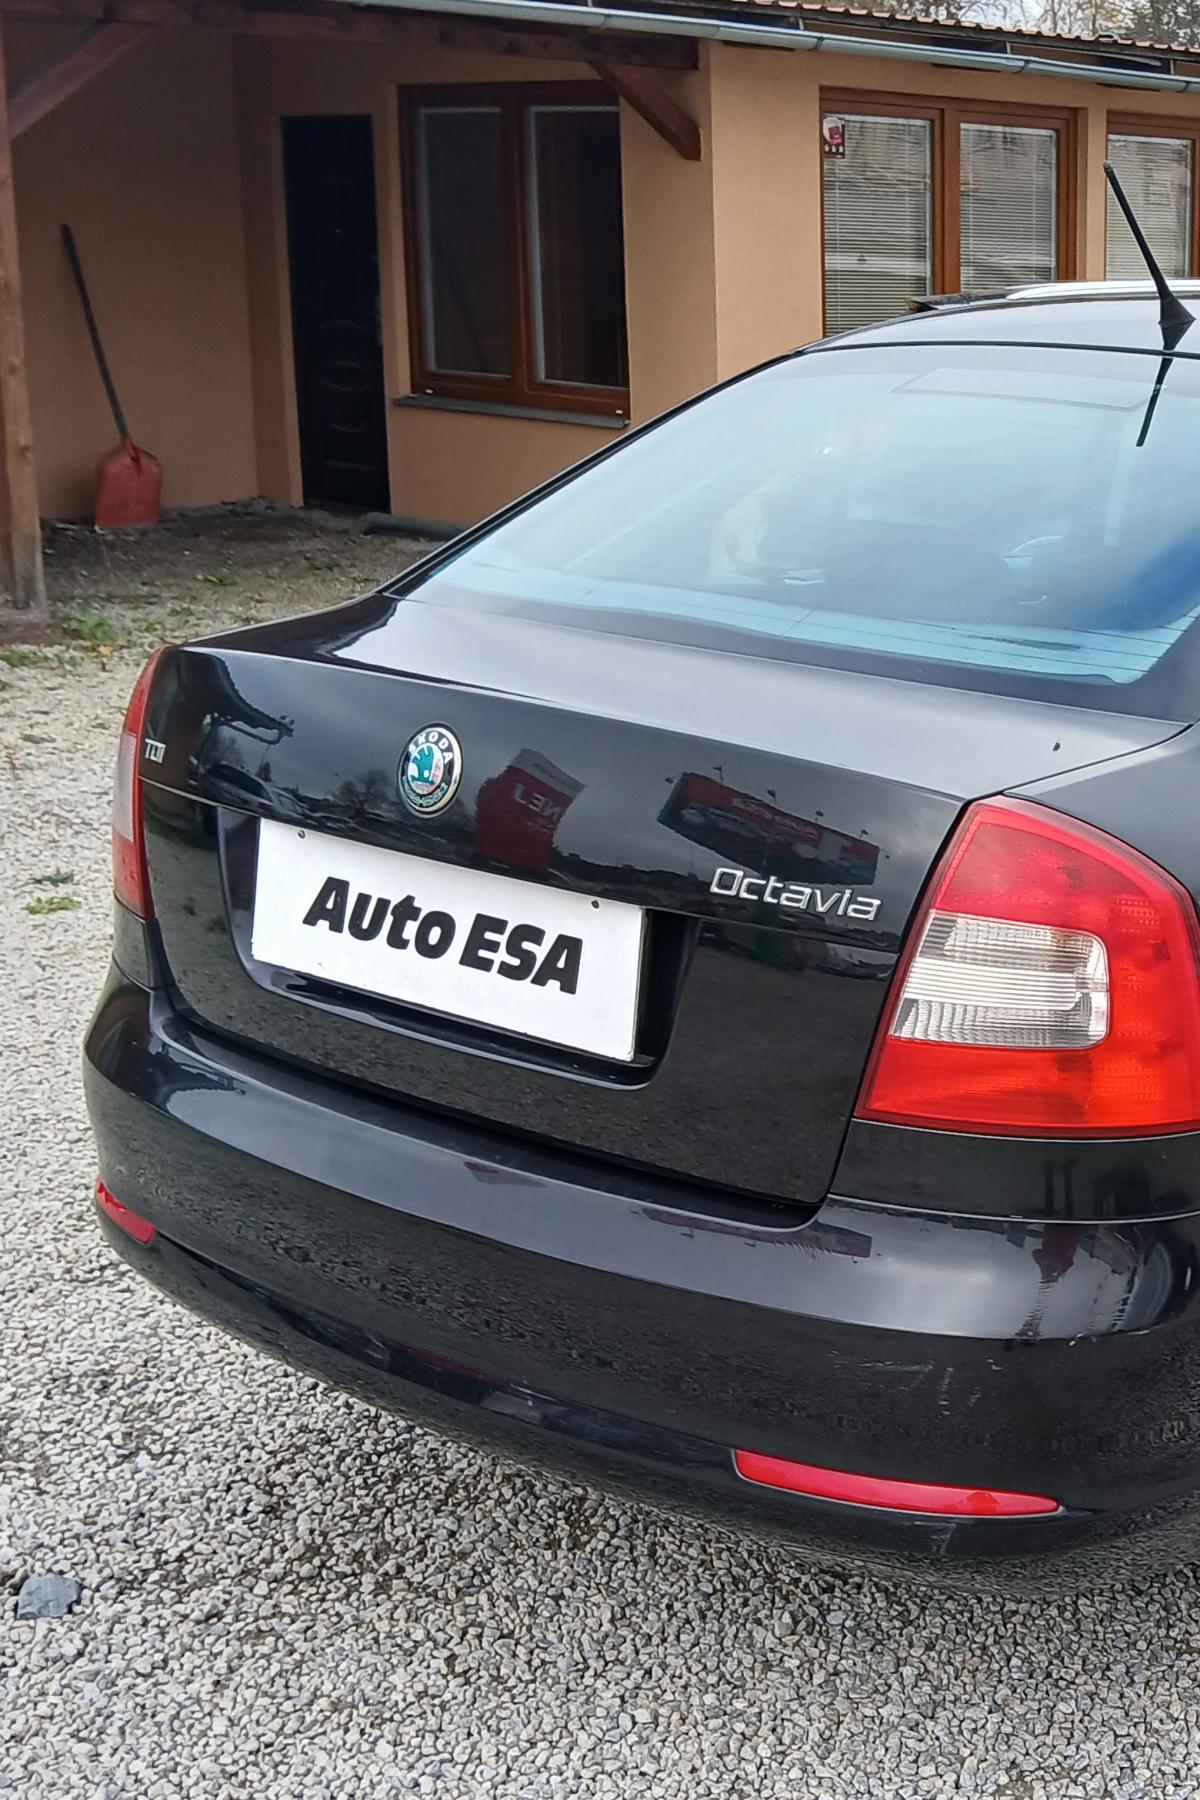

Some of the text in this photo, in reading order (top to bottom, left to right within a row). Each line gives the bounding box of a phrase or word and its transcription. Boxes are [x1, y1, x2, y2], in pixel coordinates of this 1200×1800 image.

[144, 738, 166, 764] TDI
[709, 867, 882, 921] Octavia
[302, 876, 584, 995] Auto ESA
